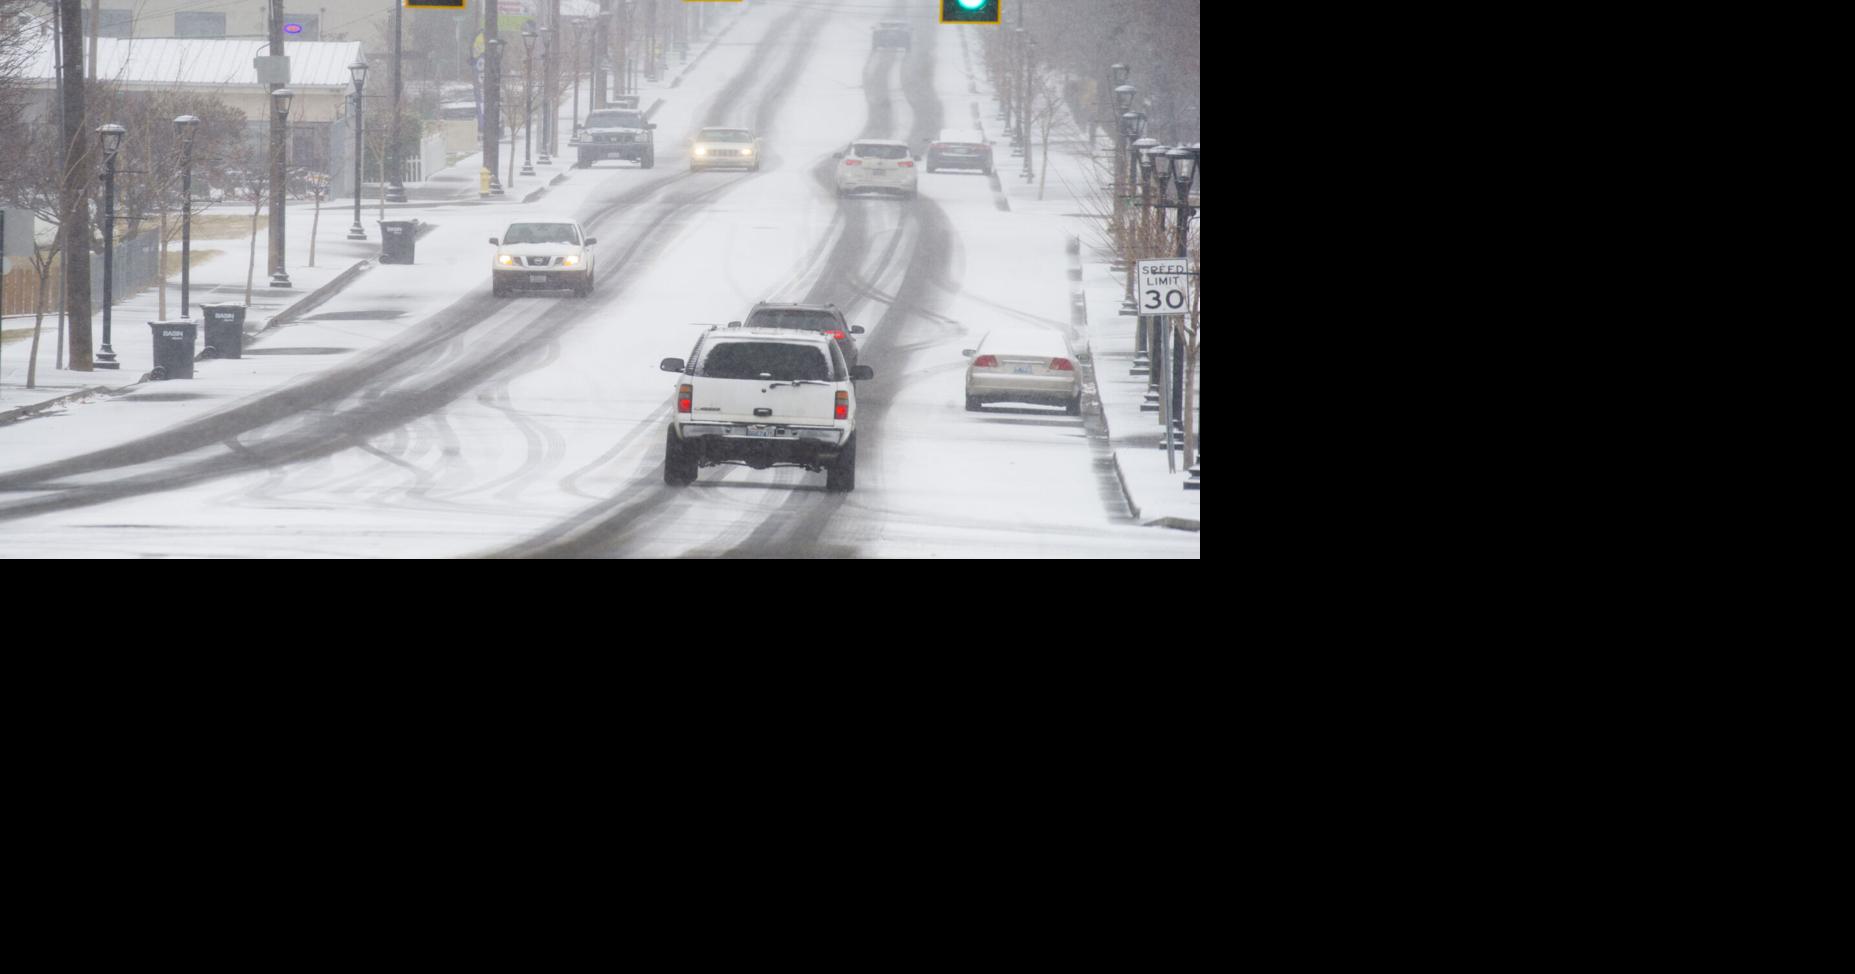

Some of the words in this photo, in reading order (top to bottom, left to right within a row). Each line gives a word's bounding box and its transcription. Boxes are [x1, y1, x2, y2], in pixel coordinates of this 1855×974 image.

[1142, 265, 1184, 275] SPEED
[1146, 276, 1180, 286] LIMIT
[1144, 289, 1184, 309] 30
